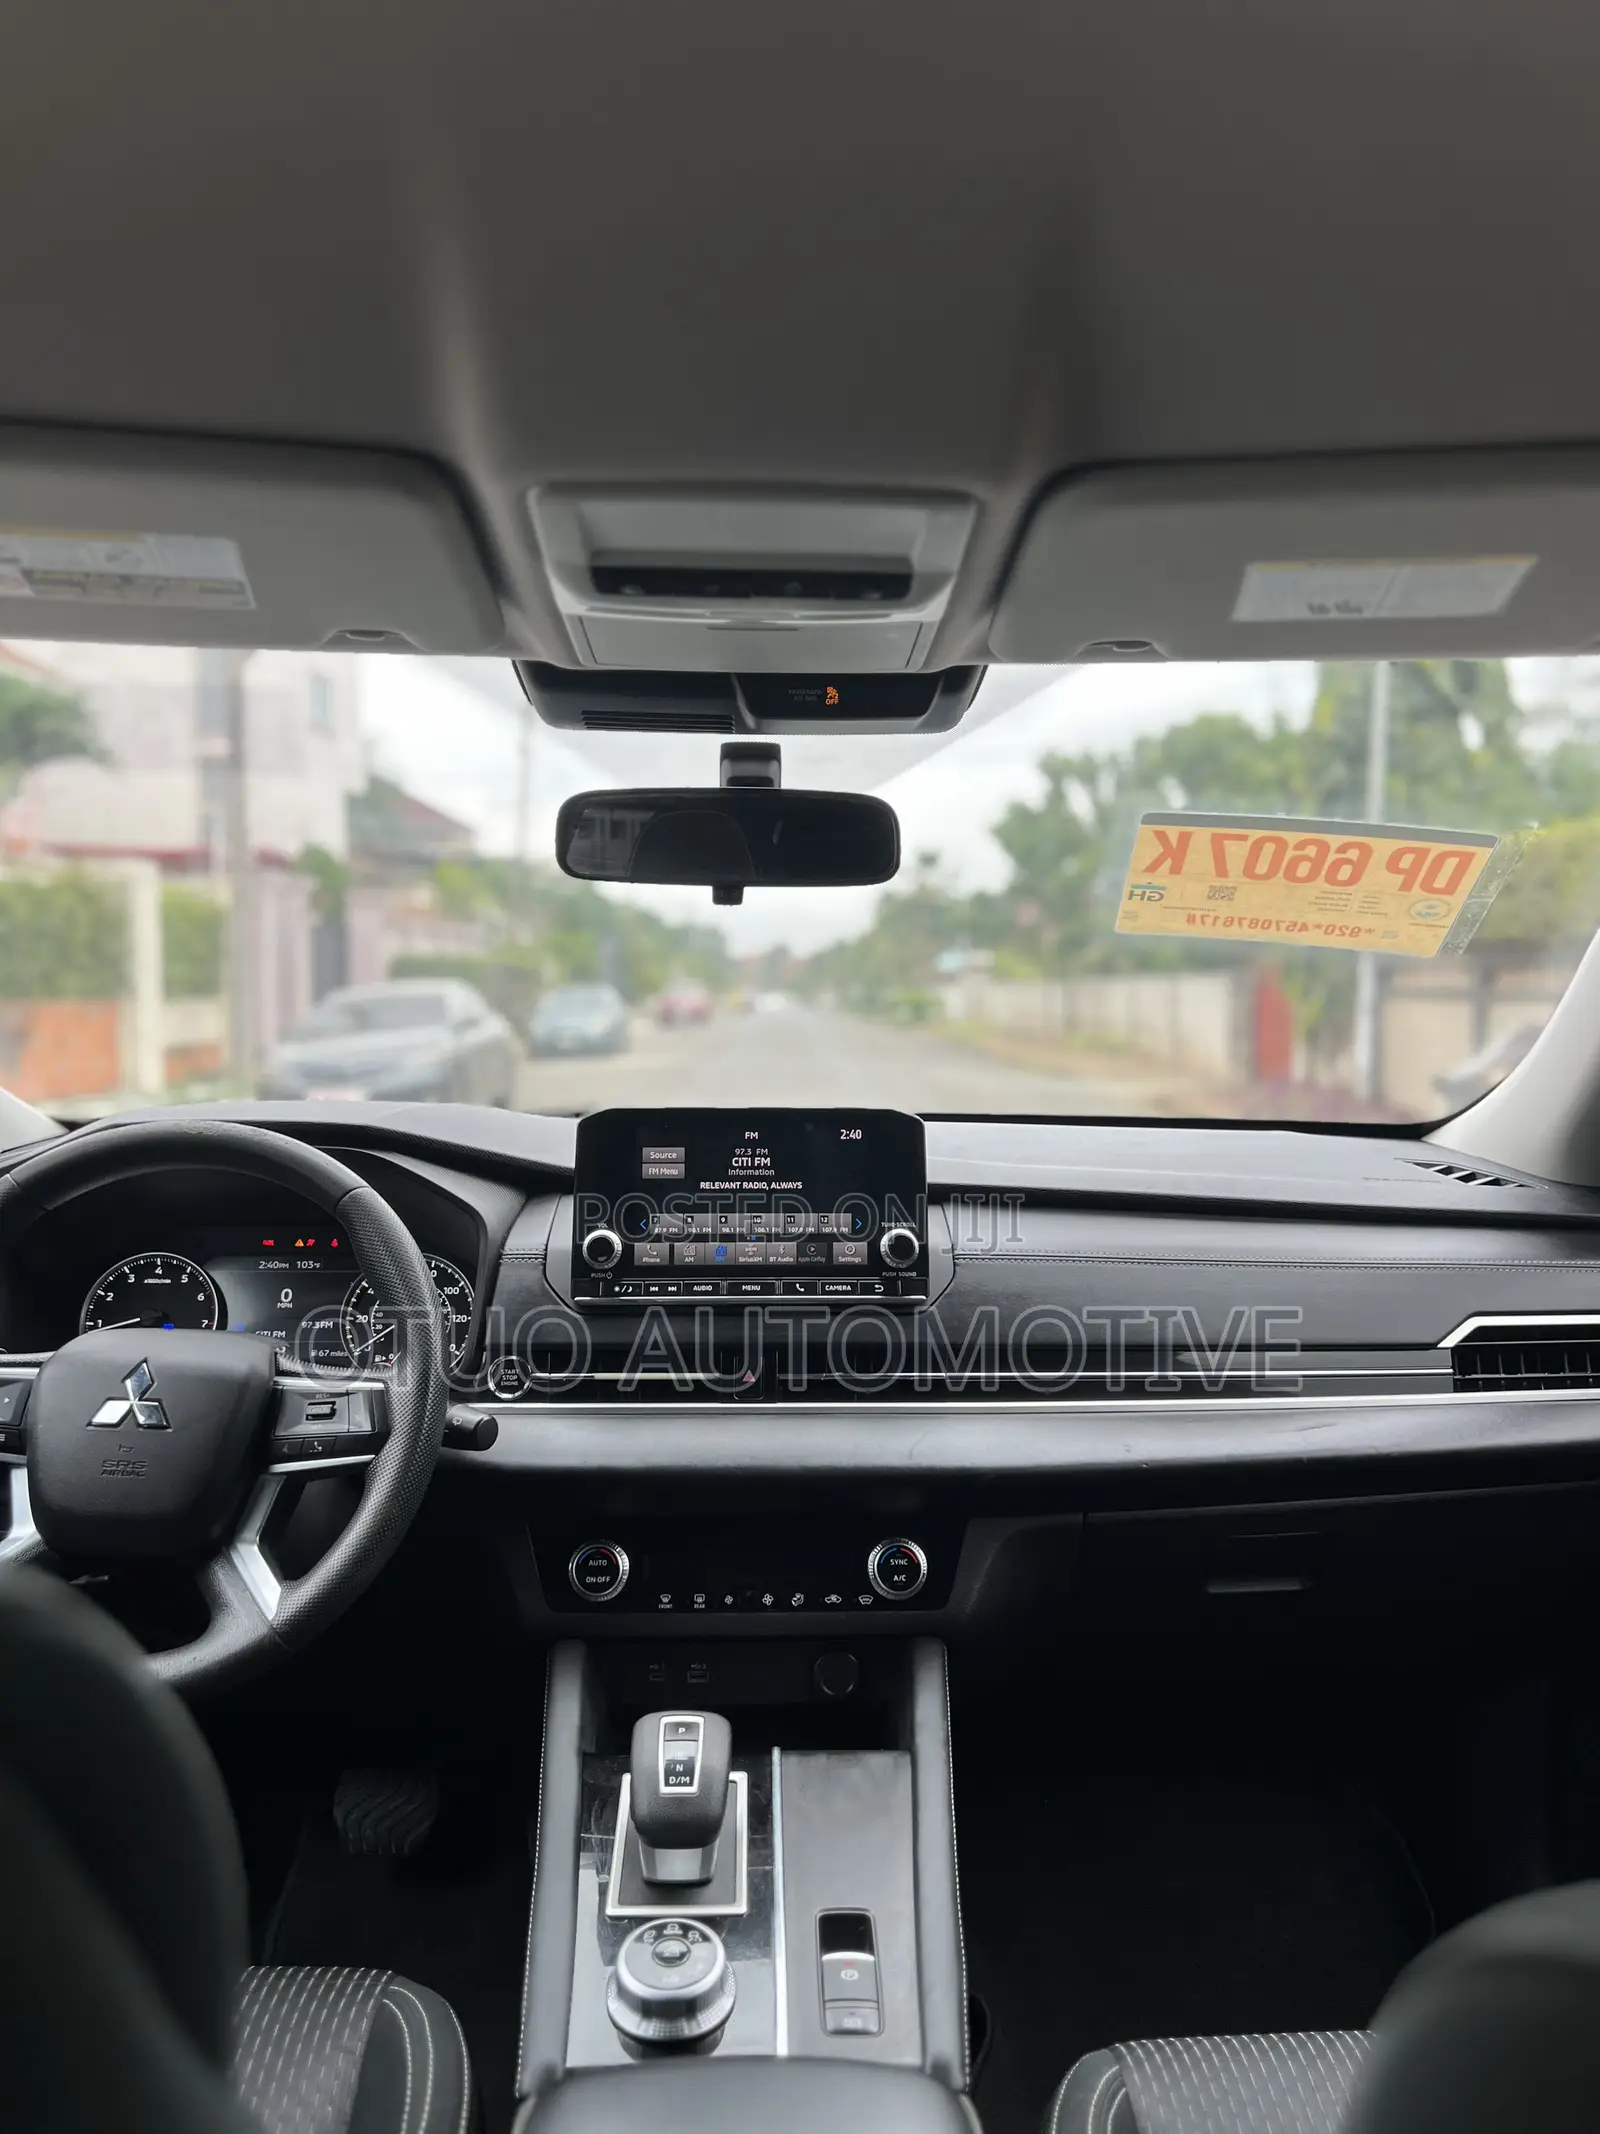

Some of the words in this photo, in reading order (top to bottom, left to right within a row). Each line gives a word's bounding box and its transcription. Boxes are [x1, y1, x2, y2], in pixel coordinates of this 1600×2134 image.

[745, 1131, 759, 1140] FM
[840, 1129, 862, 1140] 2:40
[650, 1151, 677, 1159] Source
[731, 1157, 752, 1167] CITI
[754, 1157, 771, 1167] FM
[648, 1167, 660, 1175] FM
[660, 1167, 678, 1175] Menu
[728, 1168, 775, 1176] Information
[700, 1181, 741, 1189] RELEVANT
[742, 1181, 769, 1191] RADIO,
[770, 1181, 803, 1189] ALWAYS
[155, 1266, 163, 1275] 4
[127, 1274, 135, 1283] 3
[180, 1274, 189, 1283] 5
[443, 1286, 460, 1295] 100
[105, 1292, 114, 1301] 2
[197, 1292, 205, 1301] 6
[280, 1288, 293, 1303] 0
[355, 1314, 369, 1323] 20
[452, 1314, 468, 1323] 120
[201, 1319, 209, 1328] 7
[272, 1330, 286, 1338] FM
[318, 1349, 330, 1357] 67
[101, 1459, 148, 1470] SRS
[588, 1559, 608, 1567] AUTO
[890, 1558, 909, 1566] SYNC
[893, 1574, 907, 1582] A/C
[675, 1763, 684, 1772] N
[668, 1775, 690, 1784] D/M
